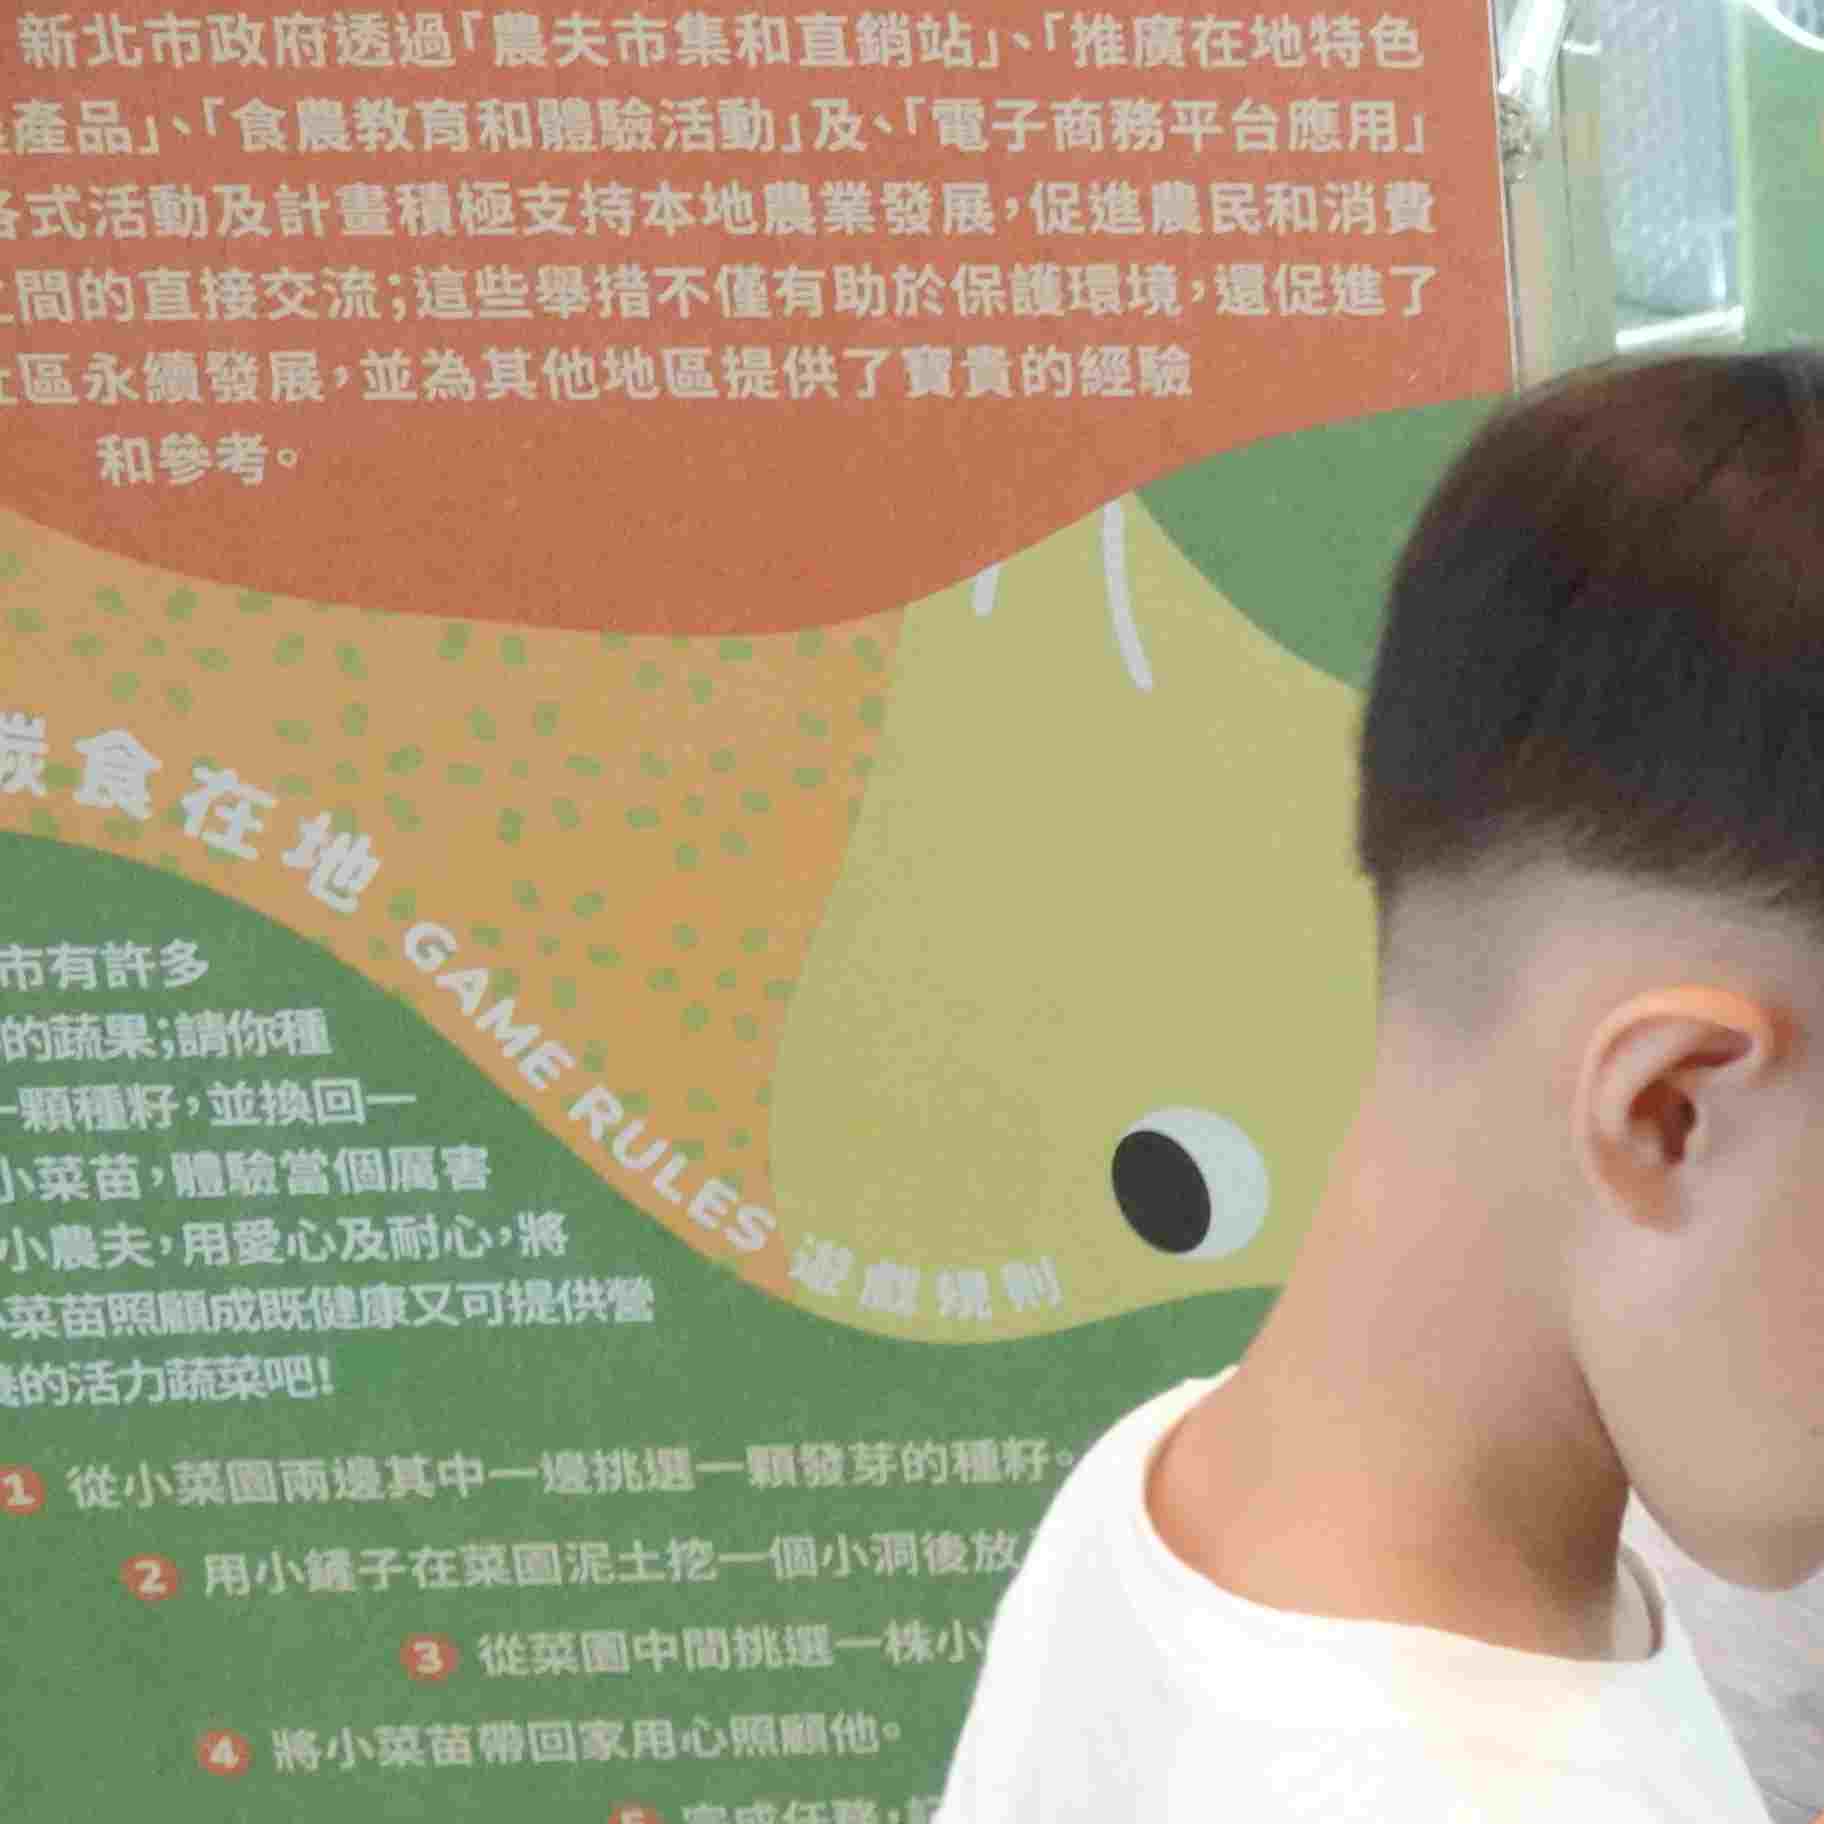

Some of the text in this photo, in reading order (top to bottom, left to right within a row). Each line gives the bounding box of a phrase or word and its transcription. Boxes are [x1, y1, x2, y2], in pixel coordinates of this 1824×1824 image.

[97, 432, 300, 488] 和參考。
[402, 920, 778, 1256] GAME RULES
